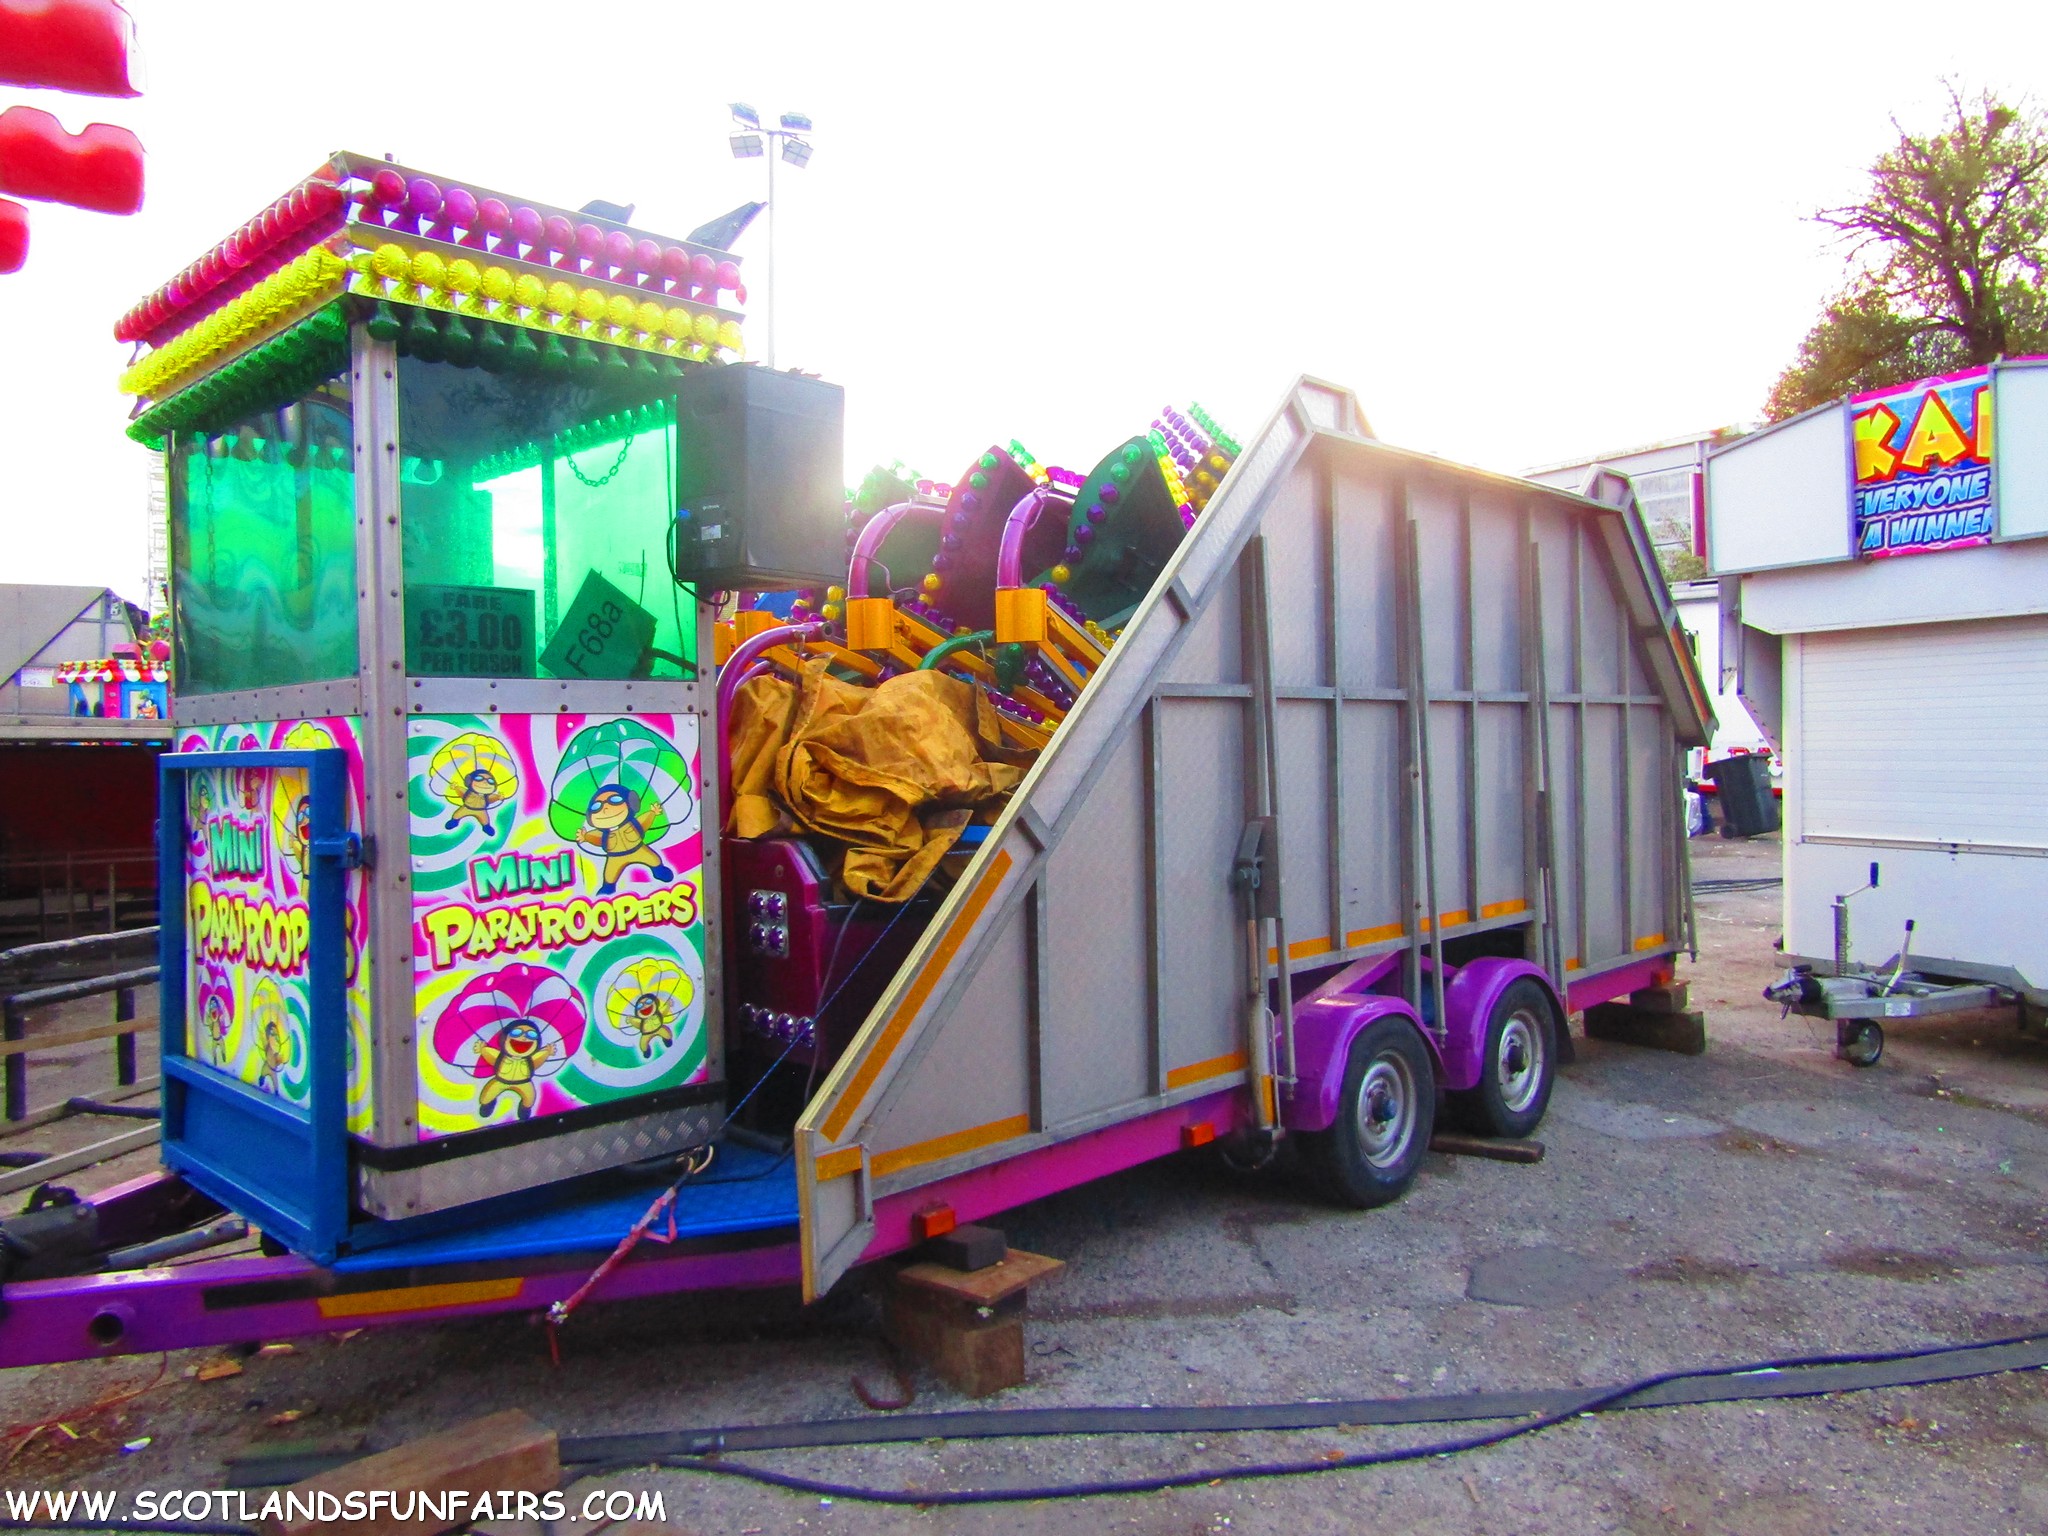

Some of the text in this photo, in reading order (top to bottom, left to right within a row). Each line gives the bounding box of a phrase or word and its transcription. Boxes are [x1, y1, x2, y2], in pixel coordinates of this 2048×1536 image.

[1862, 521, 1882, 549] A
[443, 592, 502, 610] FARE
[420, 609, 522, 650] £3.00
[566, 600, 623, 677] F68a
[420, 652, 522, 674] PER PERSON
[209, 814, 265, 880] MINI
[470, 849, 574, 902] MINI
[422, 882, 697, 970] PARATROOPERS
